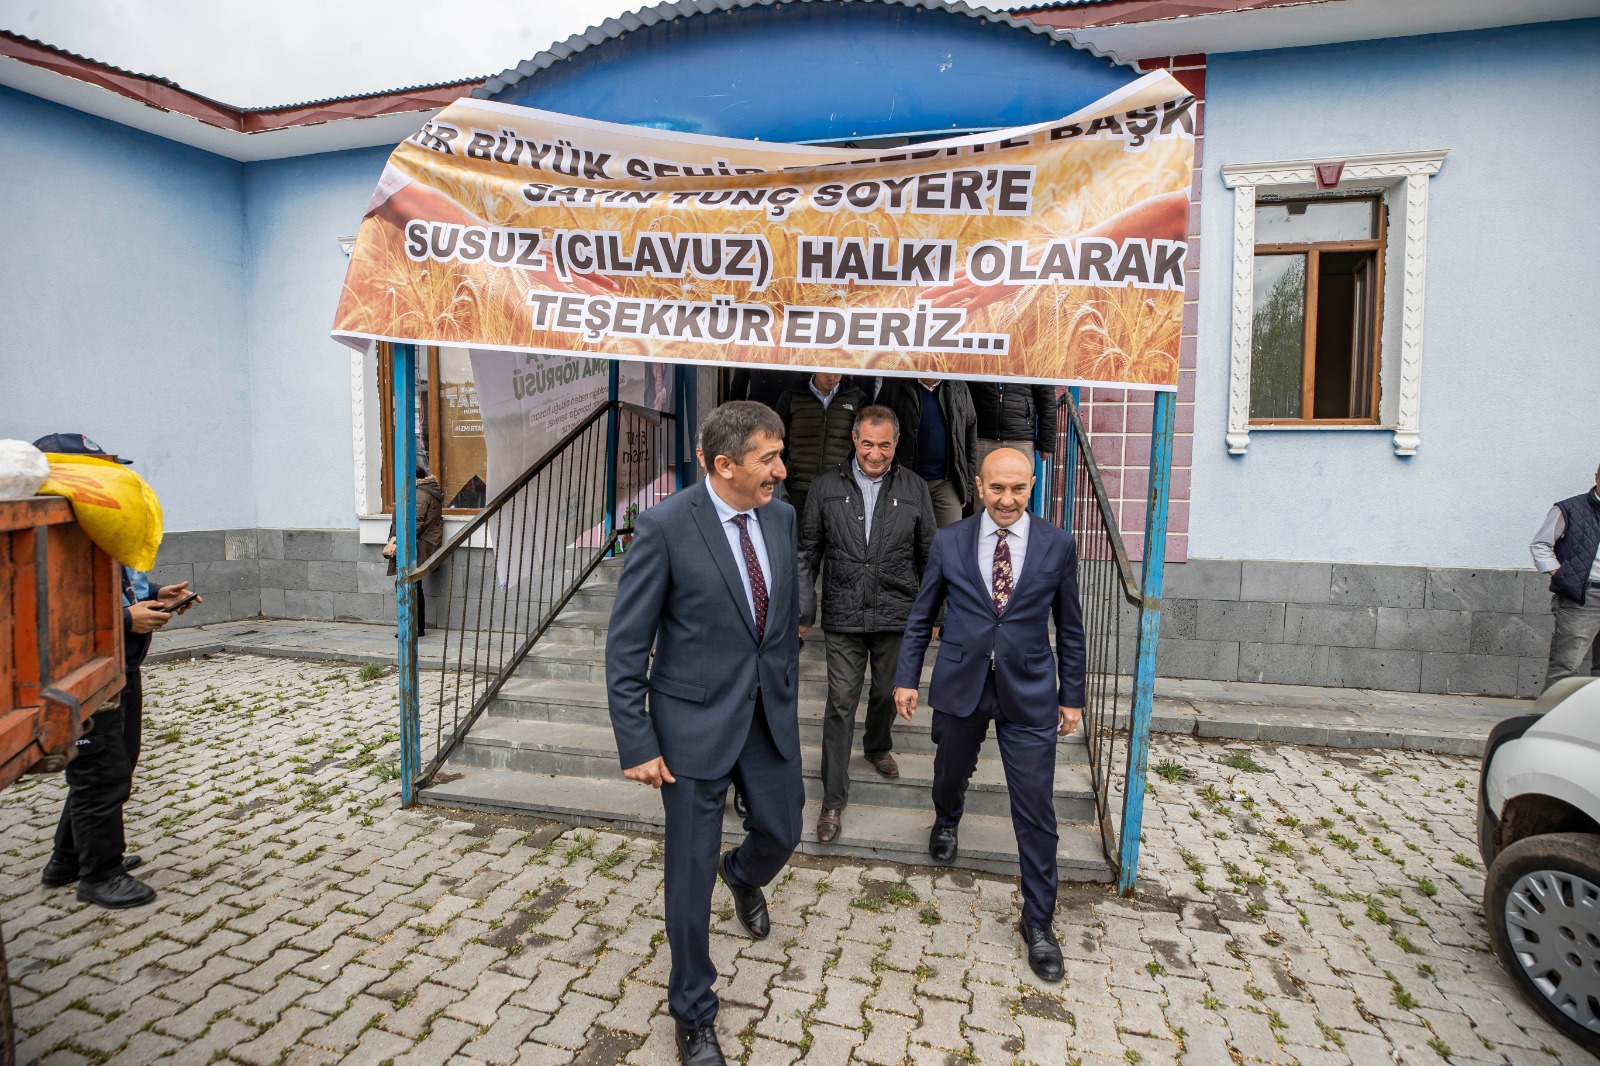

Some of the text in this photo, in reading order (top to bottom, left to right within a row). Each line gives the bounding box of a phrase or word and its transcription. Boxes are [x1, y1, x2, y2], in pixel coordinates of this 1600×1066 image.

[467, 130, 615, 180] BÜYÜK
[523, 184, 658, 204] SAYIN
[673, 188, 800, 217] TUNÇ
[406, 223, 1187, 287] SUSUZ (CILAVUZ) HALKI OLARAK
[531, 294, 1005, 350] TEŞEKKÜR EDERİZ...
